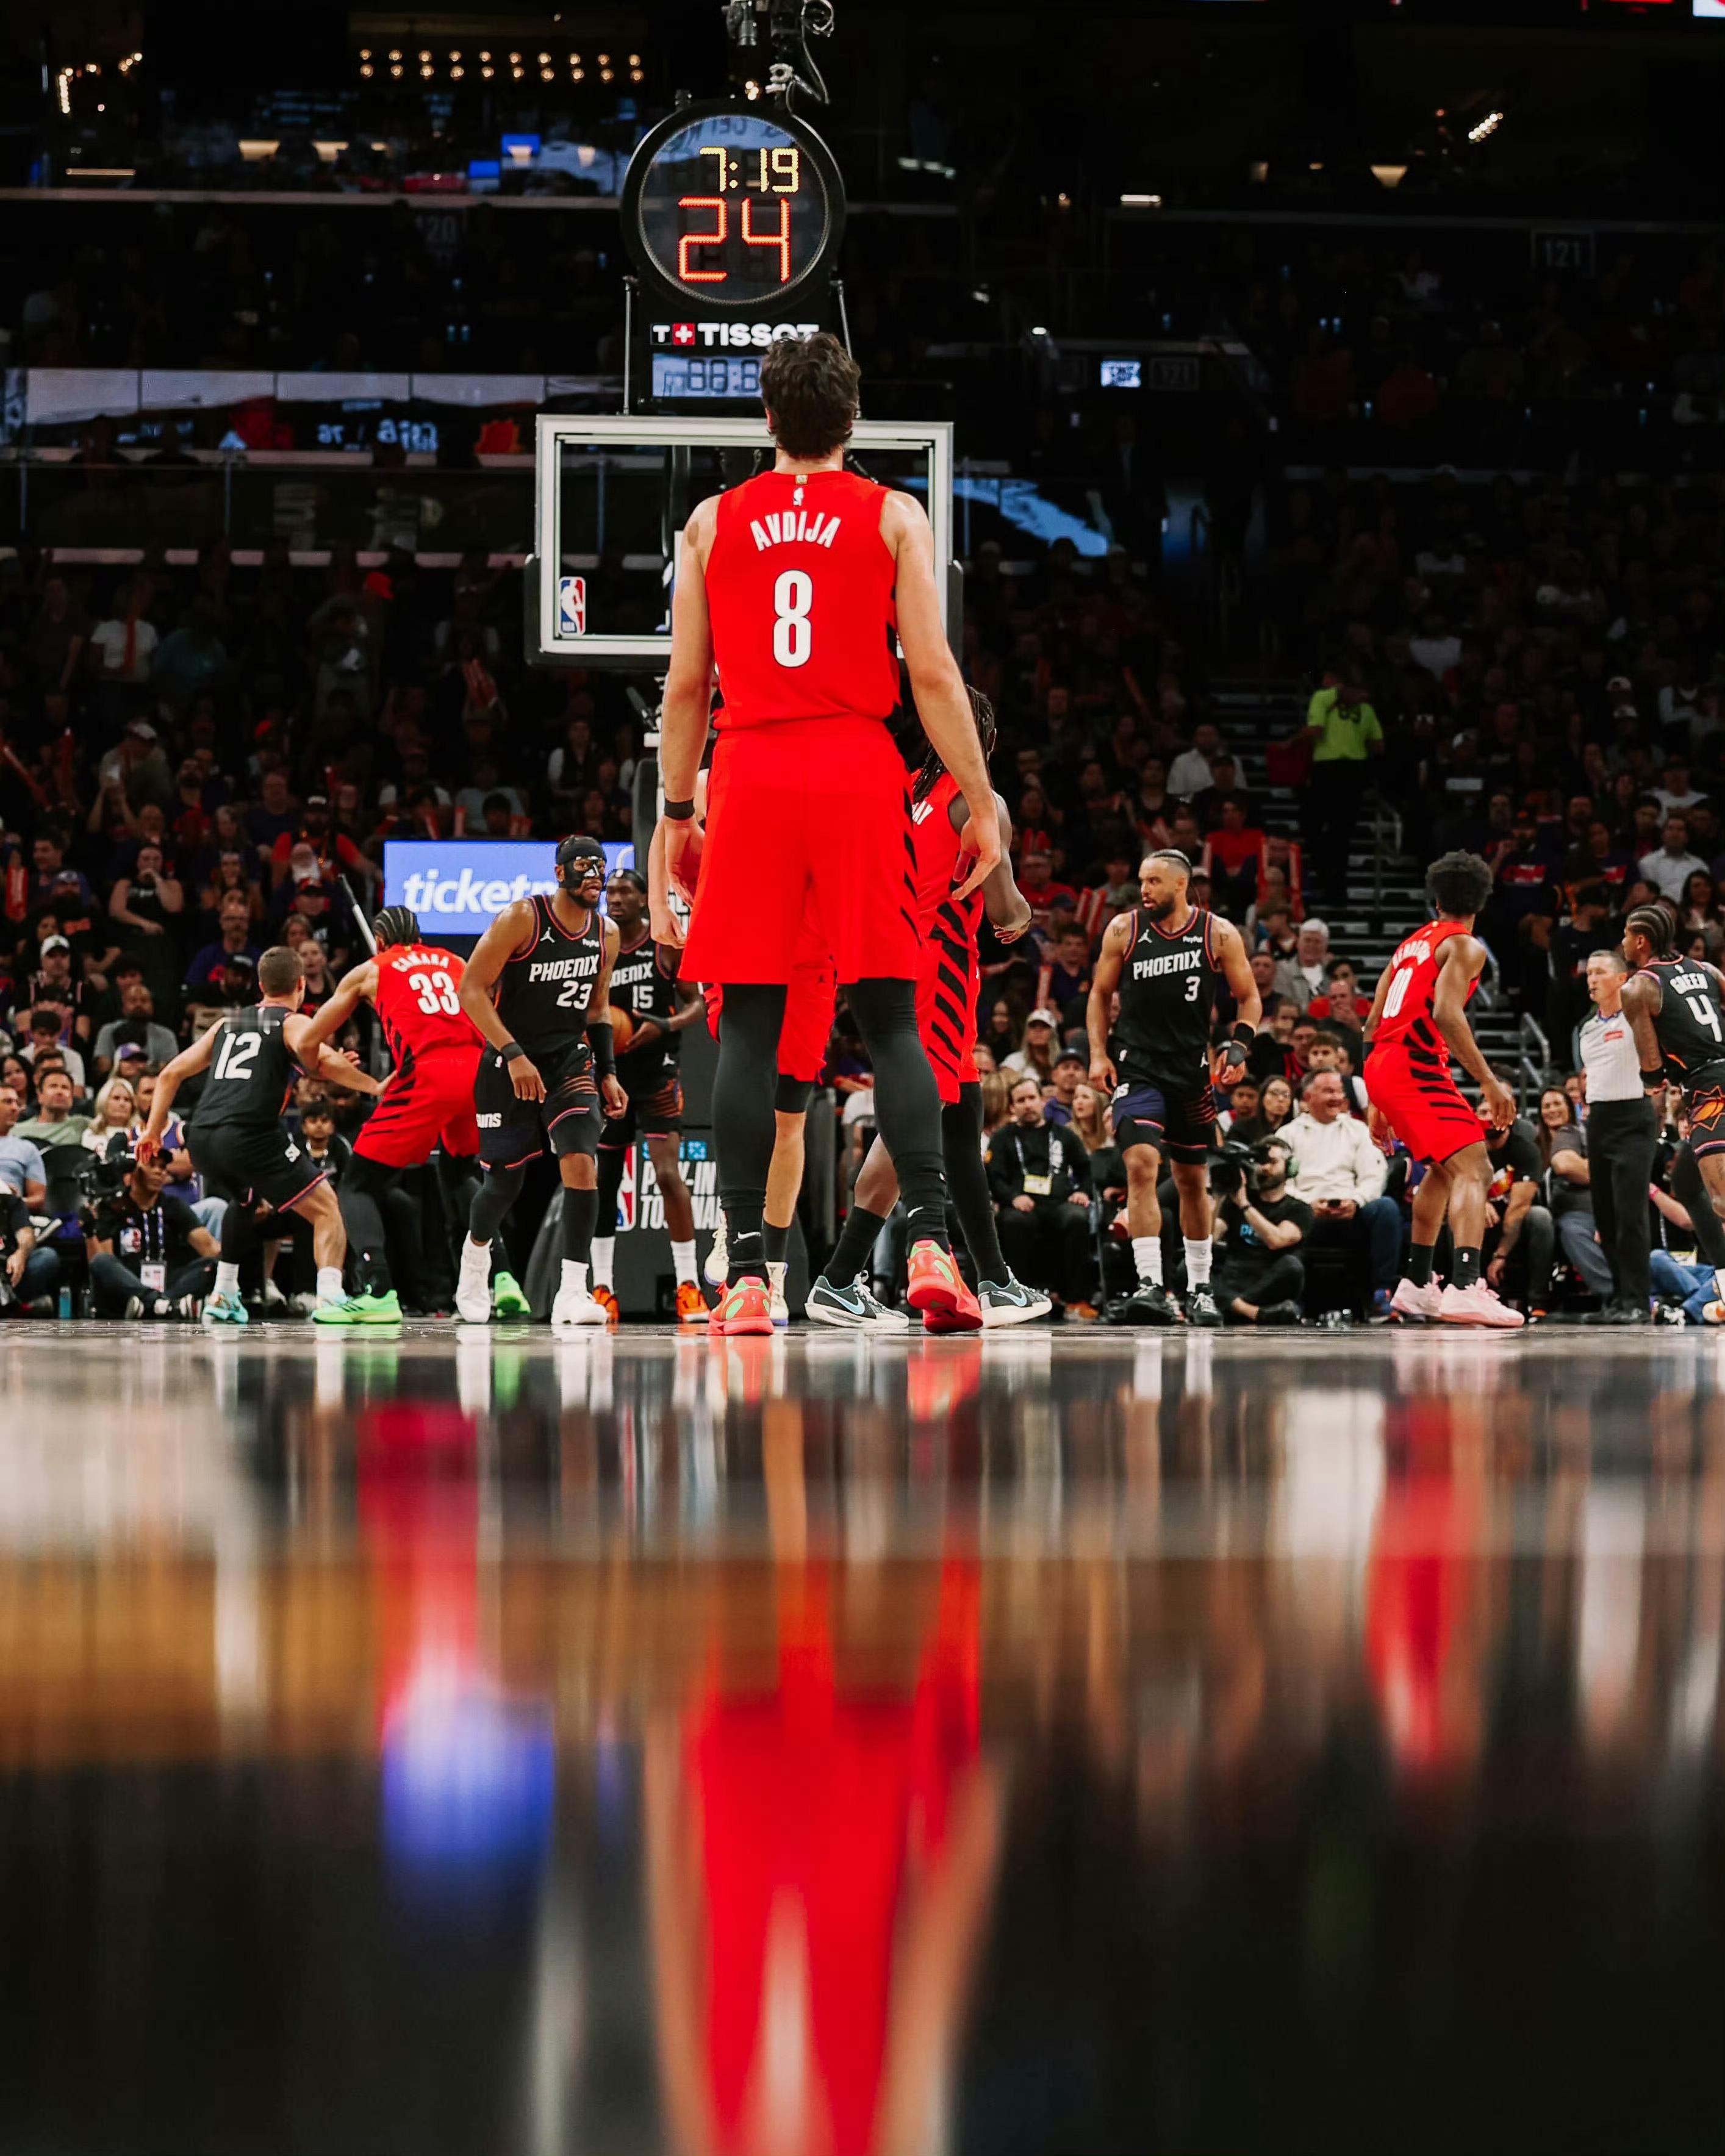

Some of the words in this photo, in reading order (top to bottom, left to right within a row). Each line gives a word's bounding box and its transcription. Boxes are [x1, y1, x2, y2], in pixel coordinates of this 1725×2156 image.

[700, 147, 799, 193] 7:19
[678, 196, 789, 283] 24
[697, 323, 820, 347] TISSOT
[750, 510, 841, 552] AVDIJA
[773, 569, 812, 668] 8
[529, 954, 600, 982] PHOENIX
[609, 961, 653, 987] OENIX
[1133, 949, 1202, 980] PHOENIX
[408, 971, 461, 1015] 33
[556, 980, 593, 1010] 23
[633, 984, 654, 1009] 15
[1185, 976, 1200, 1001] 3
[1669, 973, 1708, 995] GREEN
[1685, 994, 1723, 1042] 4
[214, 1031, 262, 1080] 12
[641, 1161, 716, 1195] PY-IN
